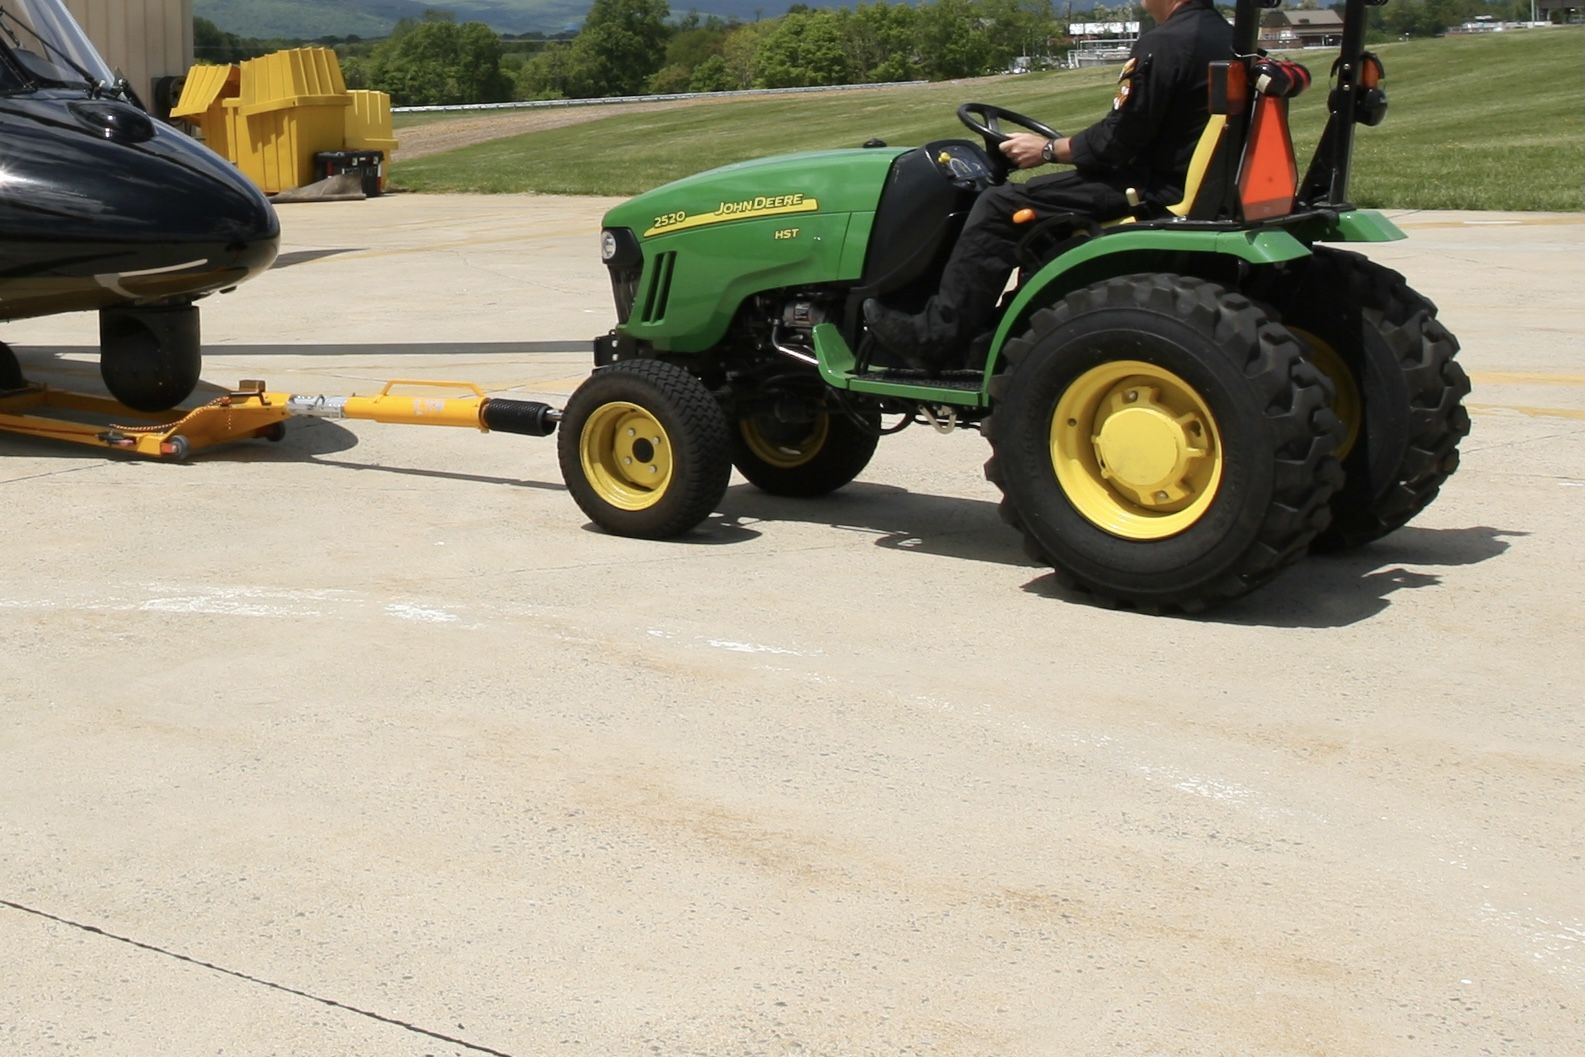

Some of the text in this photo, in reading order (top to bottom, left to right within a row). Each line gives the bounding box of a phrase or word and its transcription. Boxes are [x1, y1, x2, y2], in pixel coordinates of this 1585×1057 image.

[714, 193, 804, 216] JOHN DEERE
[653, 211, 687, 229] 2520
[774, 228, 800, 240] HST
